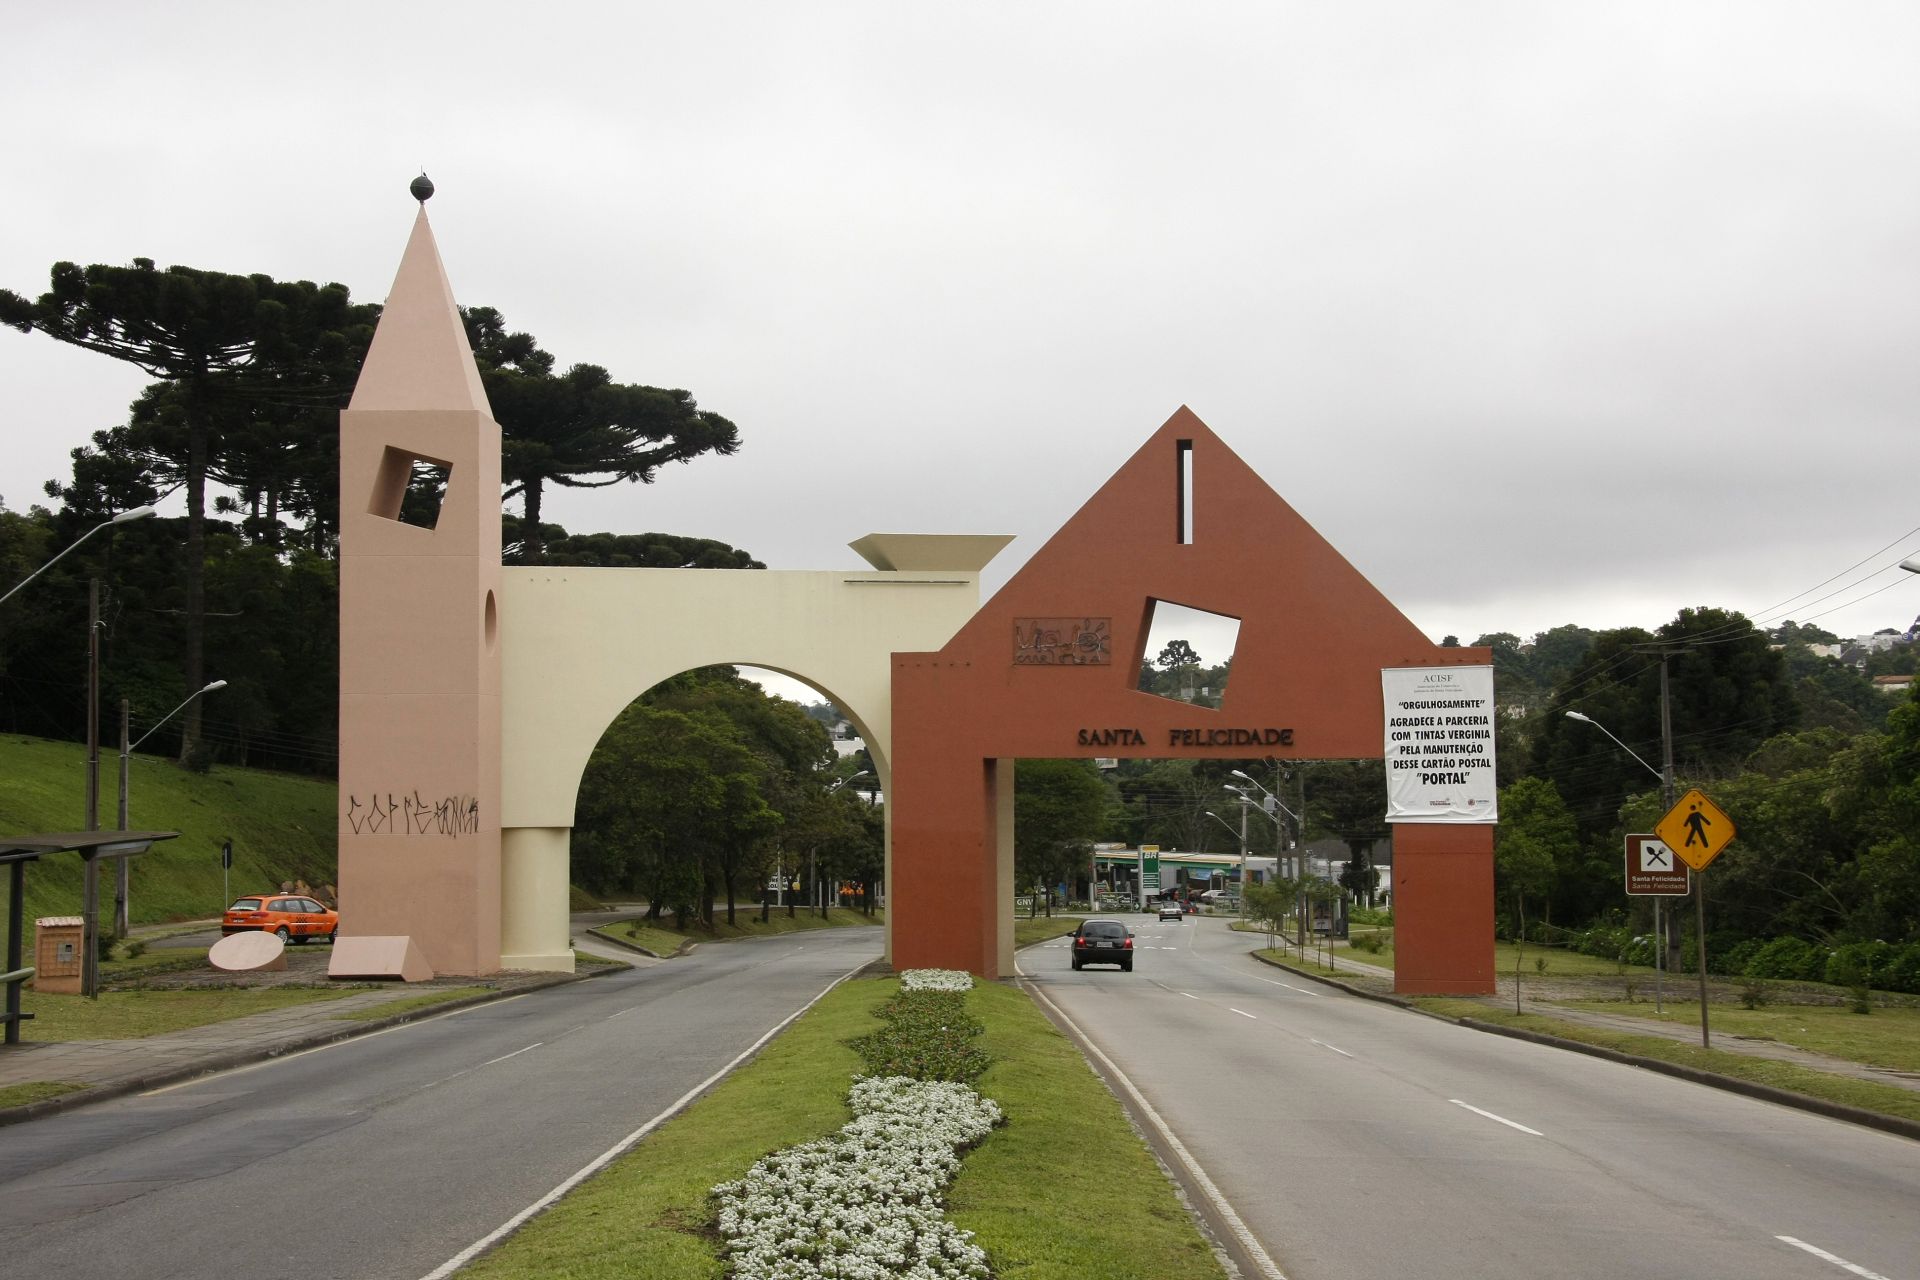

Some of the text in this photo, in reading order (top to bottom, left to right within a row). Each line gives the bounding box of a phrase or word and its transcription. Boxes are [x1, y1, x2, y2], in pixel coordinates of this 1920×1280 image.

[1423, 674, 1454, 682] ACISF
[1390, 715, 1489, 727] AGRADECE A PARCERIA
[1077, 728, 1294, 747] SANTA FELICIDADE
[1391, 729, 1491, 741] COM TINTAS VERGINIA
[1400, 741, 1483, 756] PELA MANUTENÇÃO
[1393, 757, 1491, 769] DESSE CARTÃO POSTAL
